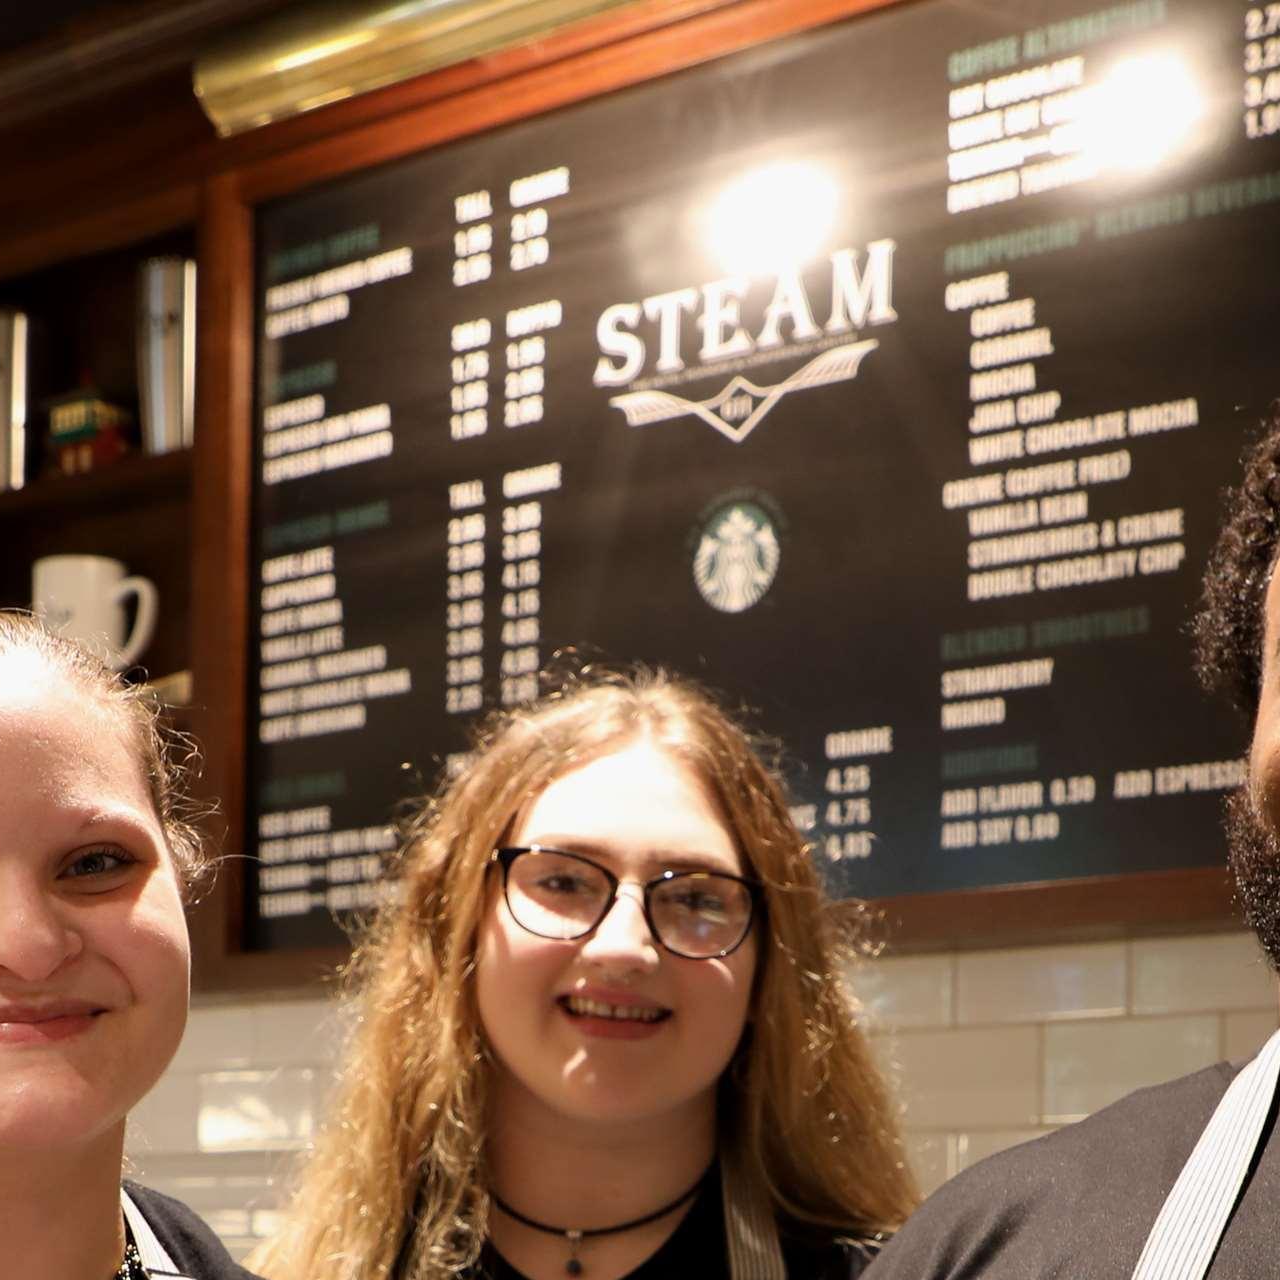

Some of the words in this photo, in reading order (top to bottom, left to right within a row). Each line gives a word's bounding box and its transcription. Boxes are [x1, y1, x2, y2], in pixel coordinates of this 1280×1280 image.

[593, 238, 898, 388] STEAM
[970, 297, 1036, 338] COFFEE
[1016, 390, 1062, 425] CHIP
[968, 429, 1026, 466] WHITE
[1025, 410, 1128, 455] CHOCOLATE
[1127, 397, 1199, 436] MOCHA
[1005, 458, 1078, 498] (COFFEE
[968, 499, 1040, 537] VANILLA
[967, 521, 1100, 569] STRAWBERRIES
[1099, 518, 1116, 548] &
[967, 564, 1036, 602] DOUBLE
[1138, 541, 1186, 576] CHIP
[941, 656, 1055, 699] STRAWBERRY
[941, 697, 1006, 731] MANGO
[824, 725, 894, 760] GRANDE
[824, 763, 871, 794] 4.25
[940, 787, 978, 817] ADD
[977, 780, 1043, 814] FLAVOR
[1113, 769, 1153, 799] ADD
[824, 797, 871, 827] 4.75
[940, 818, 978, 849] ADD
[978, 816, 1013, 847] SOY
